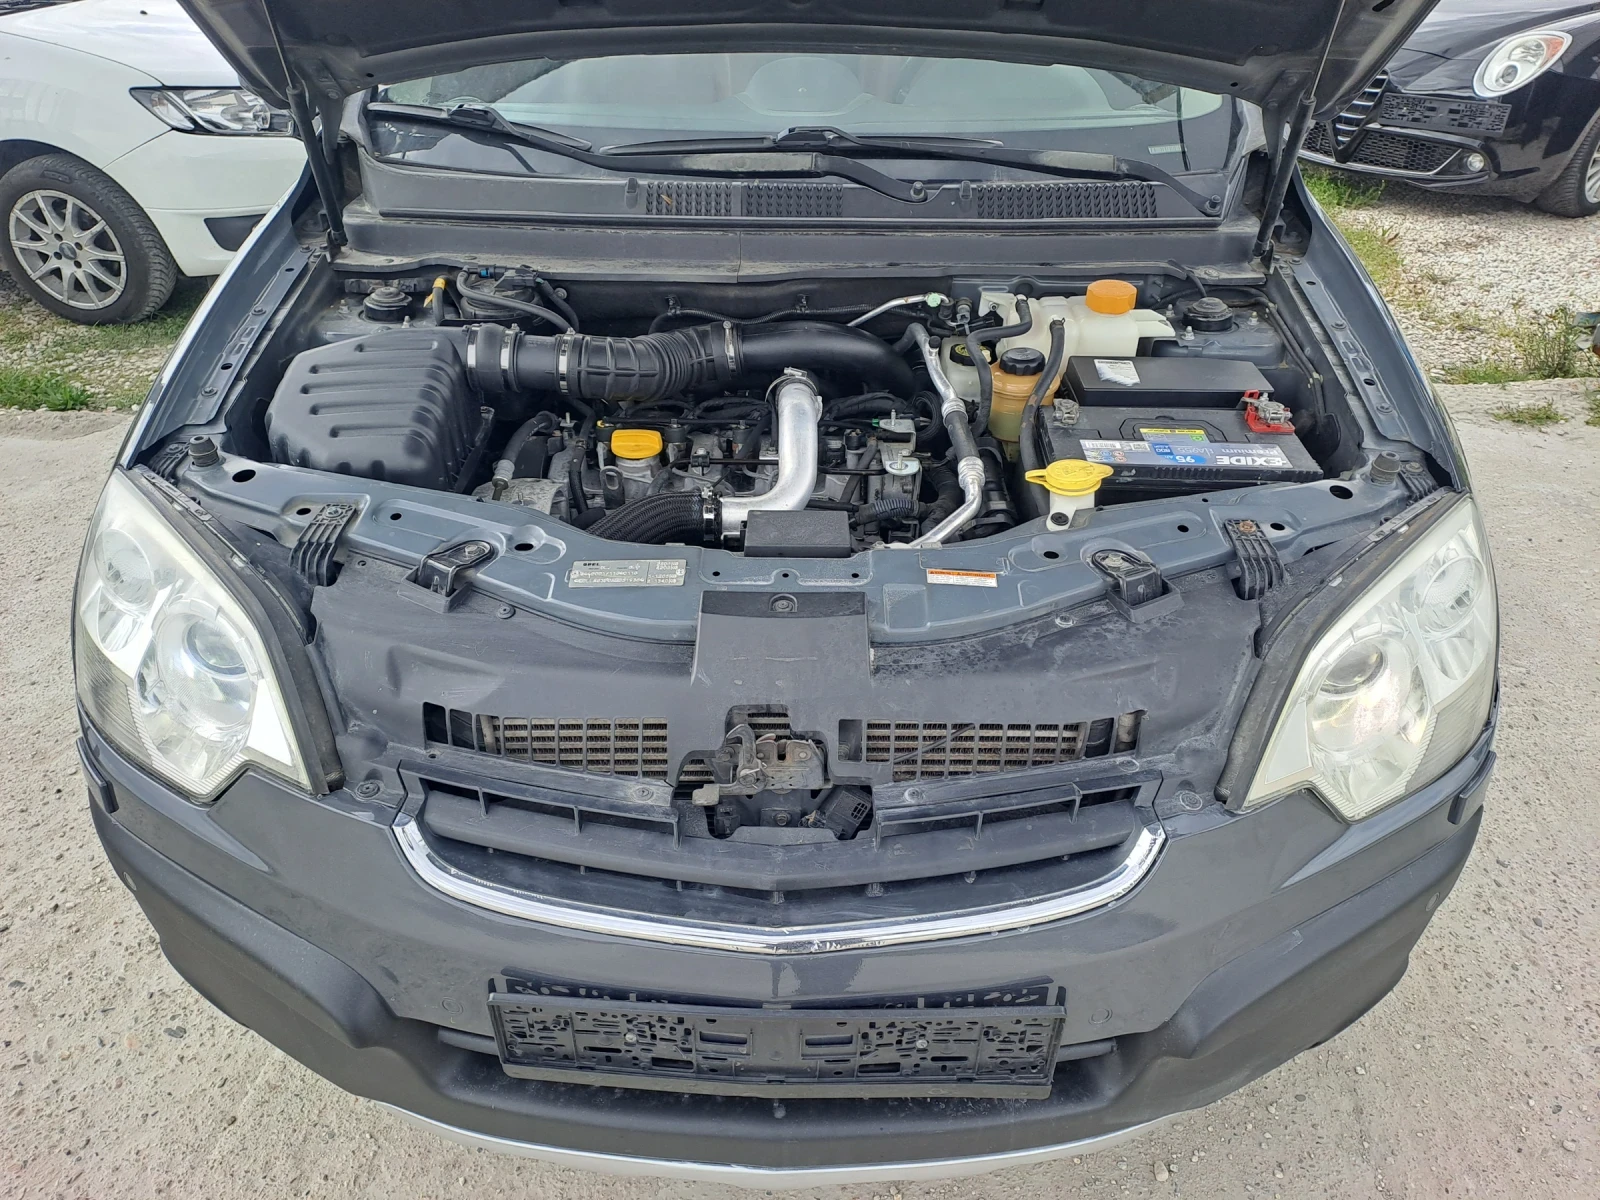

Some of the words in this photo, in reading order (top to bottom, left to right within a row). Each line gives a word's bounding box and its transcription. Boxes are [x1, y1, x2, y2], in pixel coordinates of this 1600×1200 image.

[1221, 448, 1279, 456] Premium
[1175, 455, 1196, 463] 95
[1215, 455, 1287, 466] EXIDE
